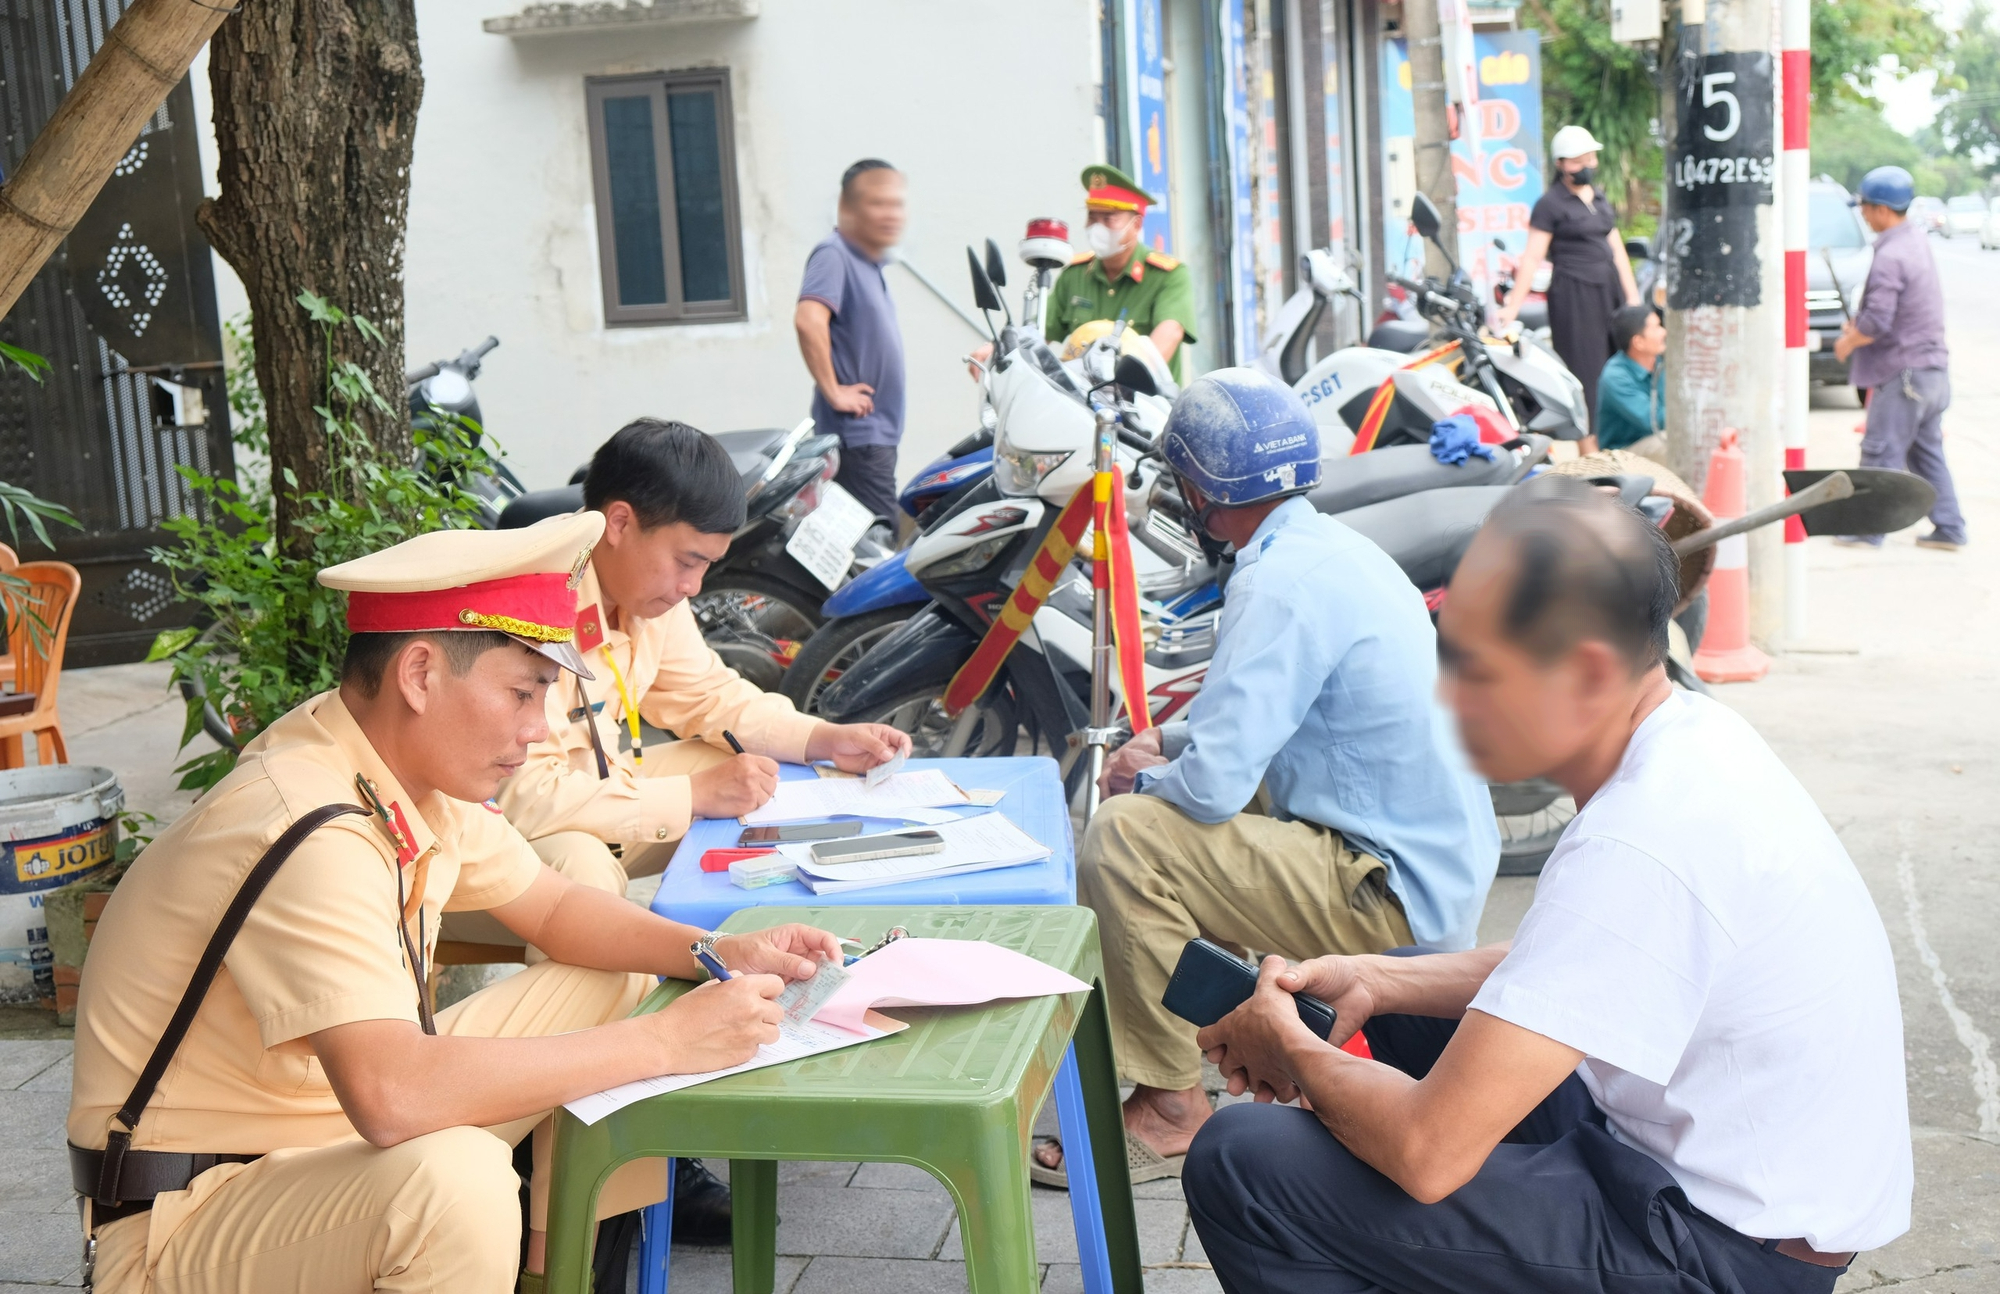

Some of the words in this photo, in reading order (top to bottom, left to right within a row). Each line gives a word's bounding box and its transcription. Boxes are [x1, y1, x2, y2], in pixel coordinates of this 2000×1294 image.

[1702, 71, 1741, 142] 5
[1301, 371, 1343, 407] CSGT
[55, 832, 114, 871] JOTU
